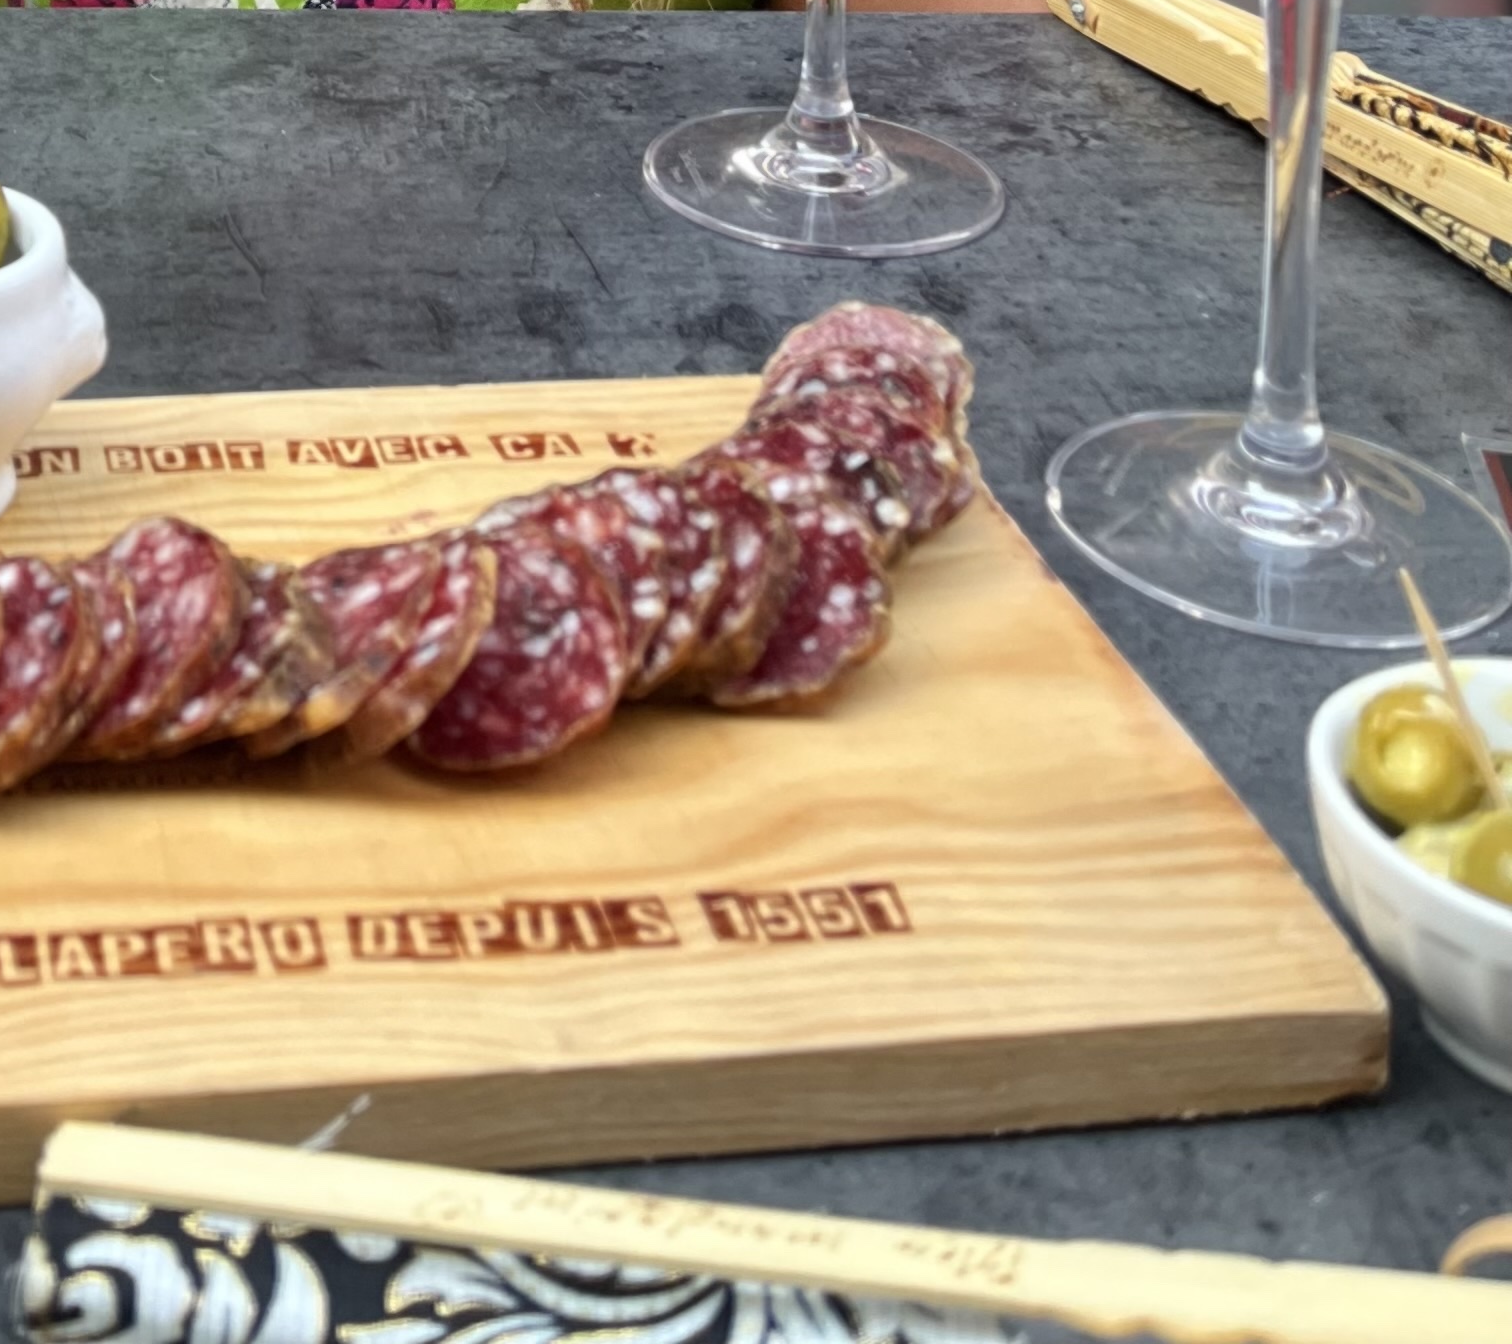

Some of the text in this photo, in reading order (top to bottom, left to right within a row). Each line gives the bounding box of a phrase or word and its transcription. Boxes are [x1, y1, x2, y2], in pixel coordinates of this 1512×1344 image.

[104, 441, 265, 473] BOIT
[288, 433, 471, 470] AVEC
[490, 432, 582, 462] CA
[348, 896, 681, 962] DEPUIS
[697, 881, 914, 941] 1551
